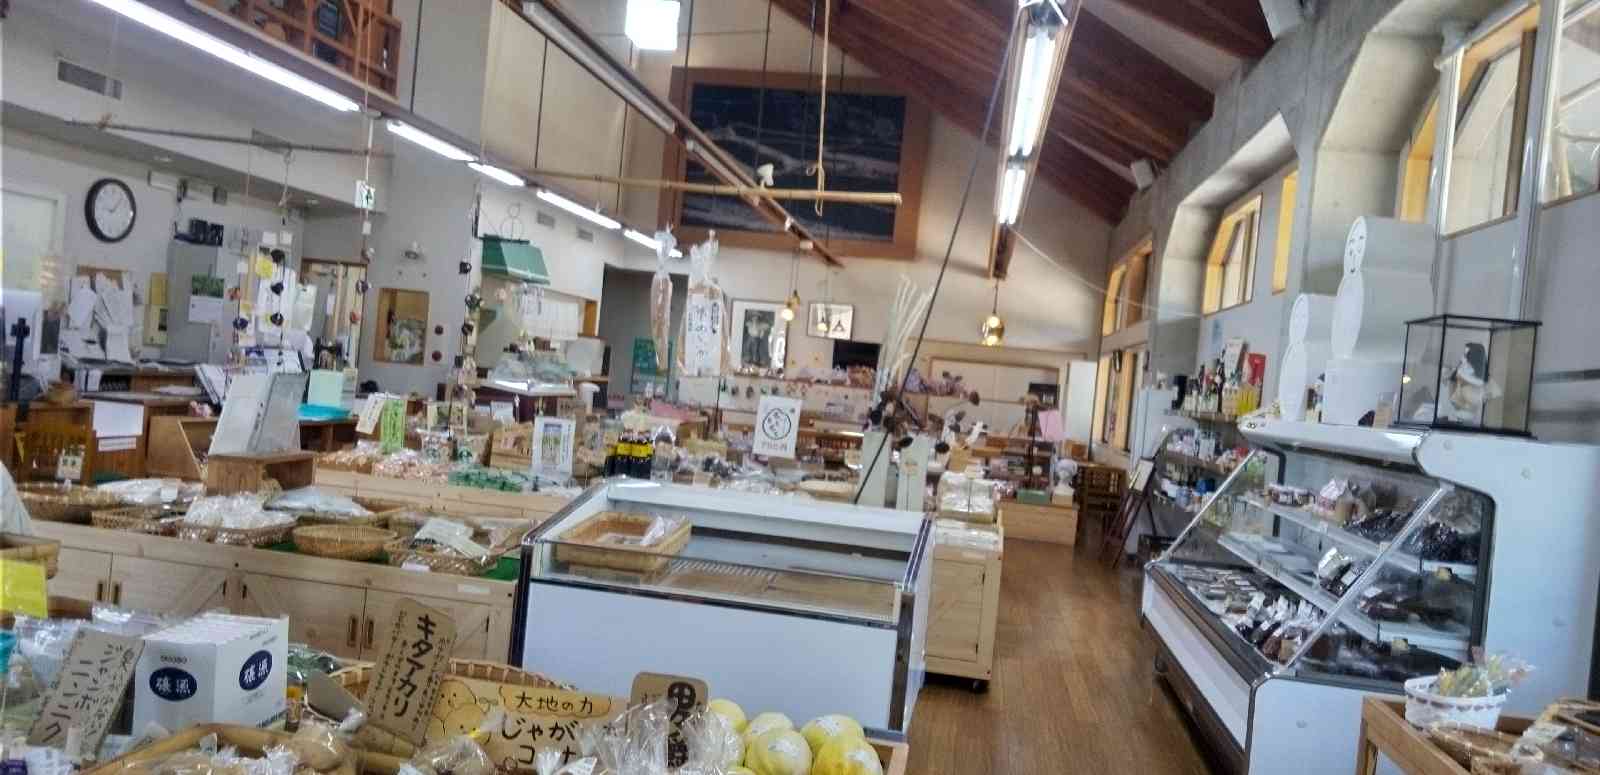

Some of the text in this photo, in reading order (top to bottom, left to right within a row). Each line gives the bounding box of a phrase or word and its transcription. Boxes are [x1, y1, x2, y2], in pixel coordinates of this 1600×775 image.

[394, 613, 437, 717] キタアカリ
[515, 690, 594, 715] 大地の力
